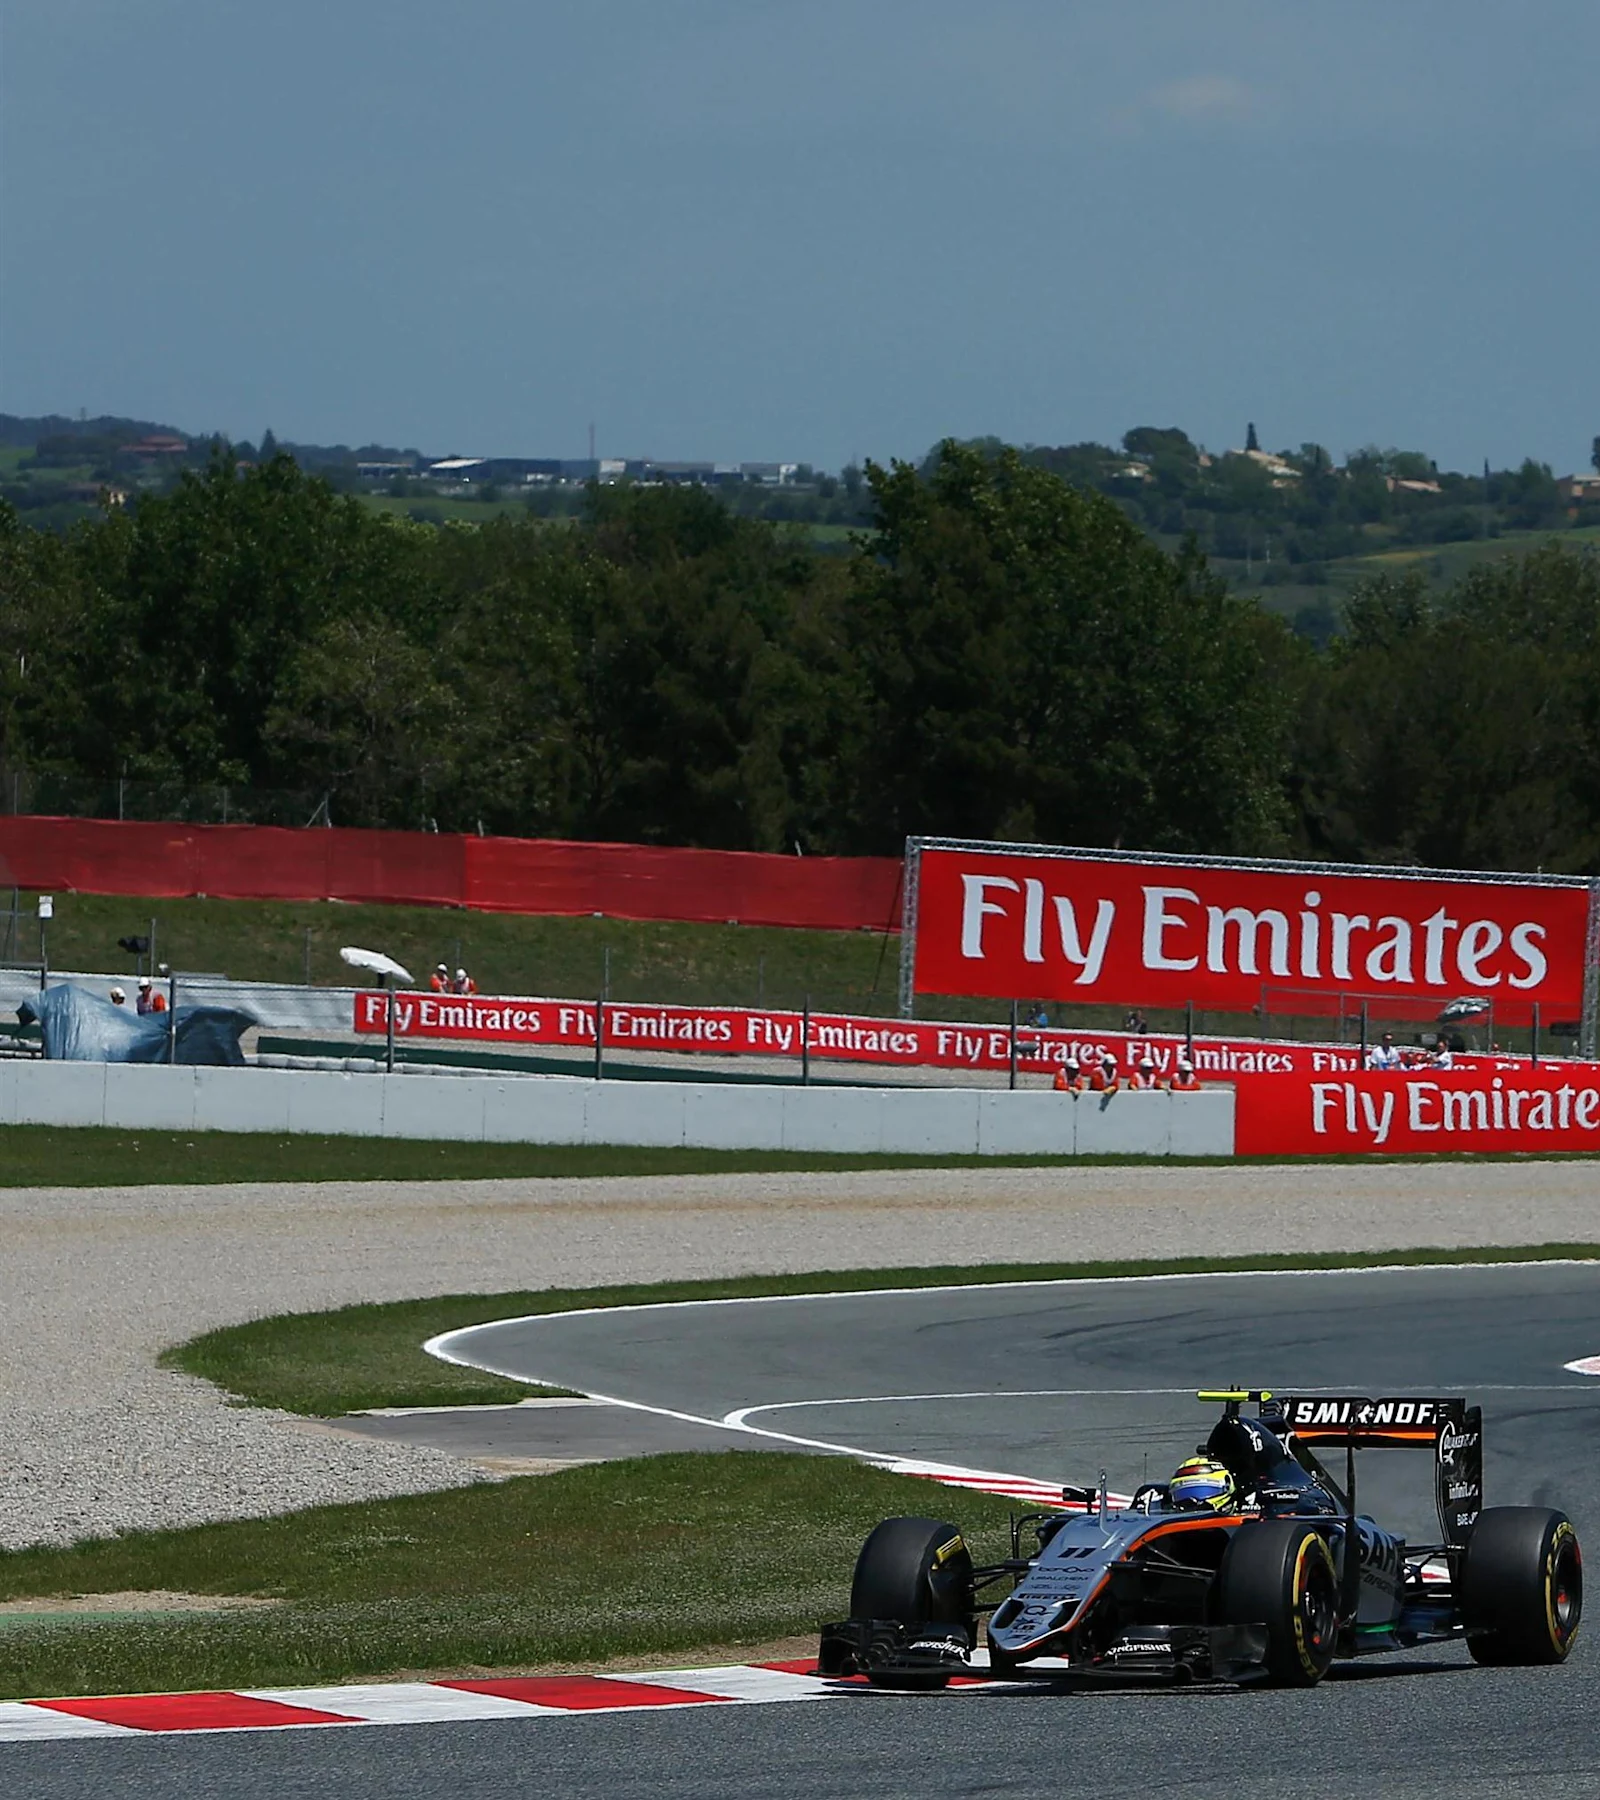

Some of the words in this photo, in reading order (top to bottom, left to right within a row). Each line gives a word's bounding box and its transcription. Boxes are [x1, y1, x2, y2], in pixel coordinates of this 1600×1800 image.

[961, 874, 1115, 985] Fly
[1142, 886, 1547, 989] Emirates
[419, 1000, 540, 1031] Emirates
[611, 1010, 731, 1041] Emirates
[747, 1017, 793, 1050] Fly
[938, 1030, 983, 1063] Fly
[1311, 1082, 1393, 1143] Fly
[1057, 1548, 1097, 1558] 11
